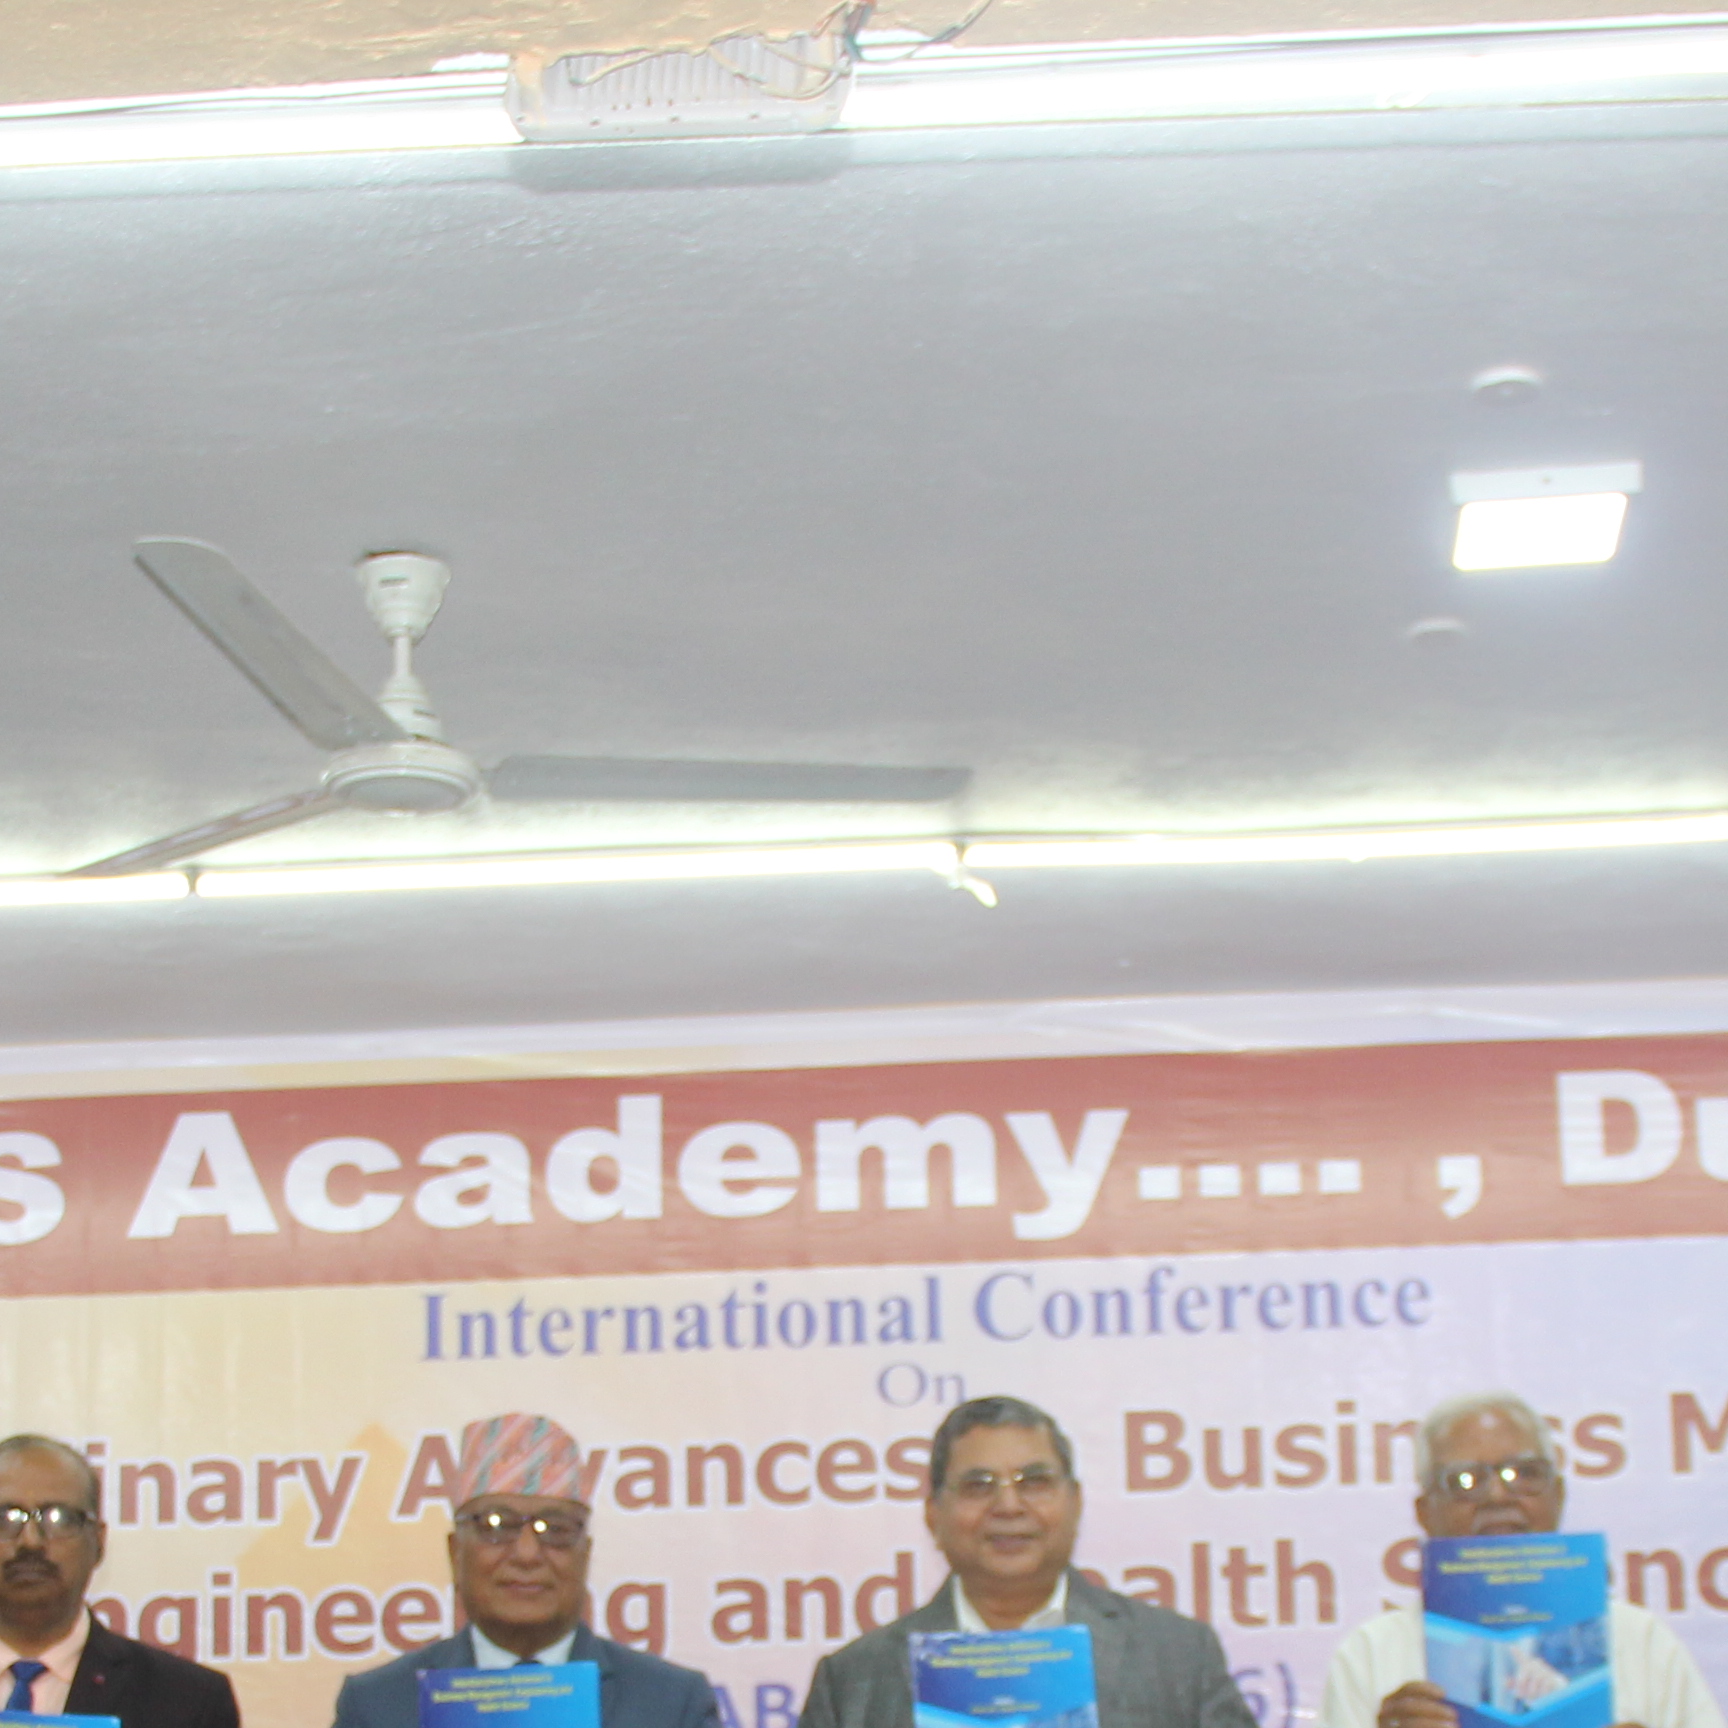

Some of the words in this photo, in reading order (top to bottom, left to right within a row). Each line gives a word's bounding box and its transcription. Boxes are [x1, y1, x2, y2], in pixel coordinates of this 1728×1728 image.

[422, 1277, 944, 1361] International
[974, 1267, 1432, 1342] Conference
[877, 1362, 967, 1408] On
[711, 1551, 917, 1643] and
